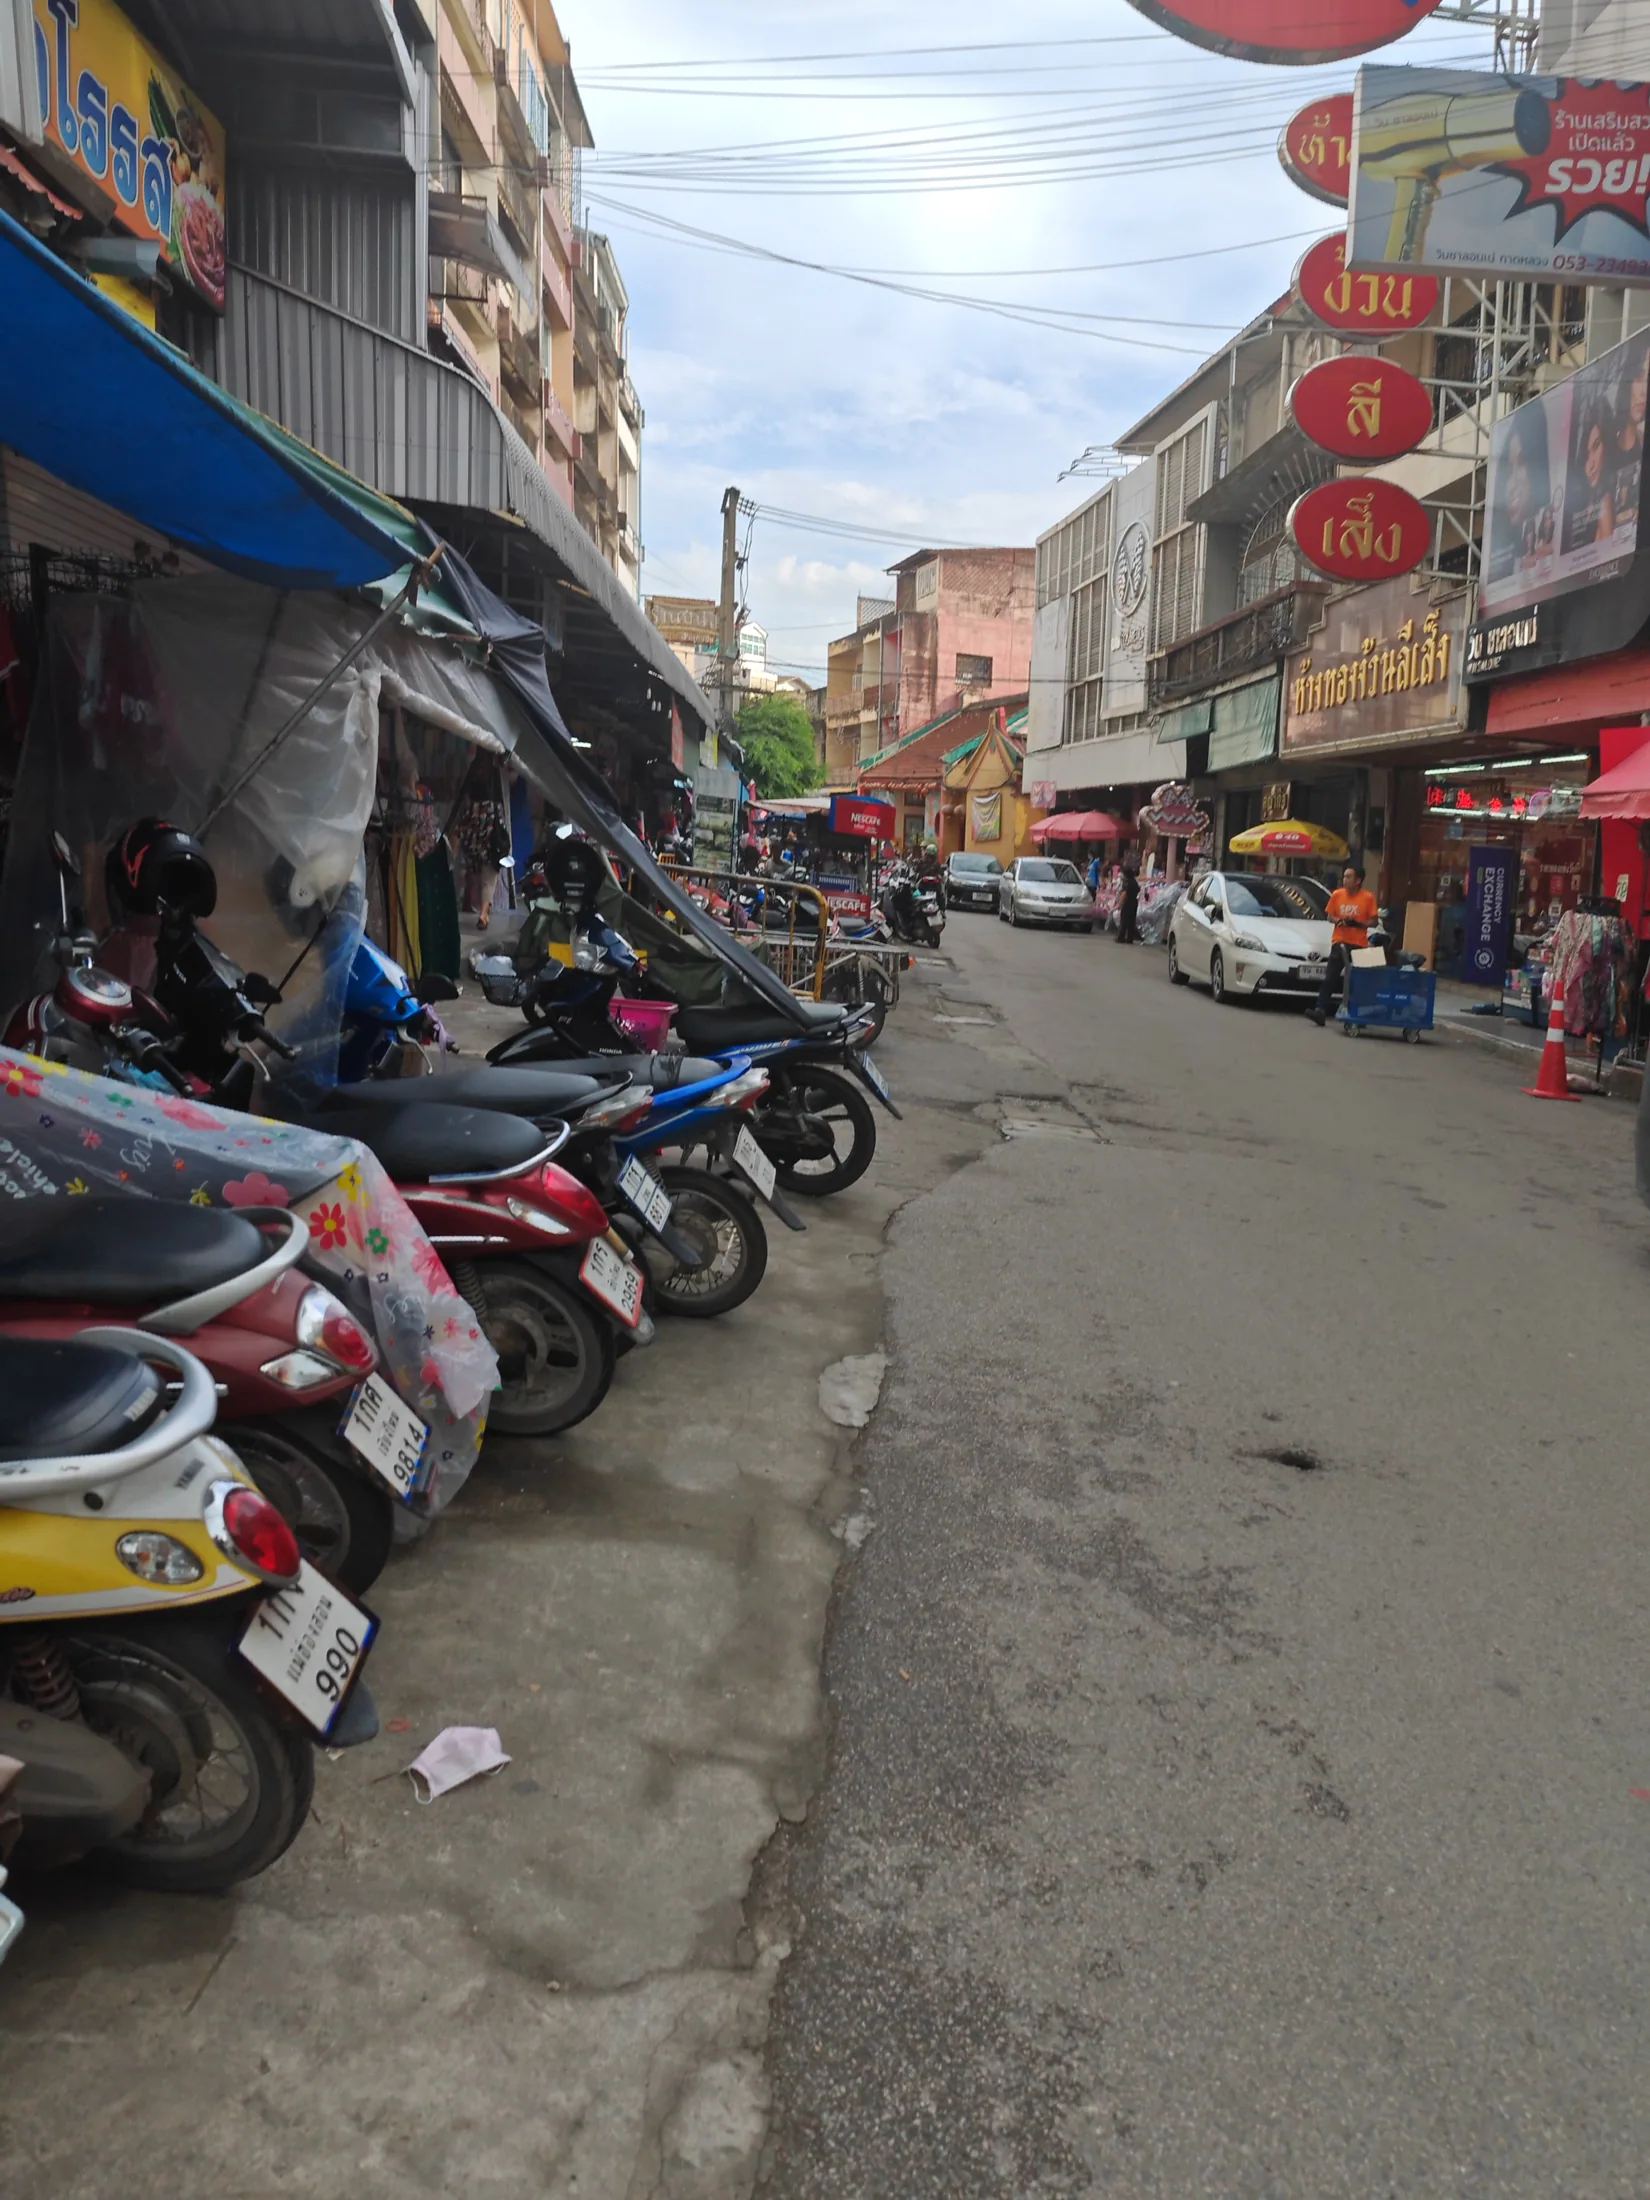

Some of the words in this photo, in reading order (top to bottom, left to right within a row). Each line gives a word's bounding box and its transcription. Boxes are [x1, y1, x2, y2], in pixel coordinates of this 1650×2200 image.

[34, 0, 173, 242] โรรส
[1298, 113, 1352, 168] ห้า
[1568, 133, 1636, 152] เปิดแล้ว
[1346, 377, 1384, 440] ลี
[1339, 904, 1359, 916] SPX
[1480, 867, 1495, 942] EXCHANGE
[1493, 867, 1506, 924] CURRENCY
[599, 1047, 623, 1055] HONDA
[621, 1272, 639, 1316] 2969
[393, 1422, 425, 1487] 9814
[315, 1627, 360, 1704] 990
